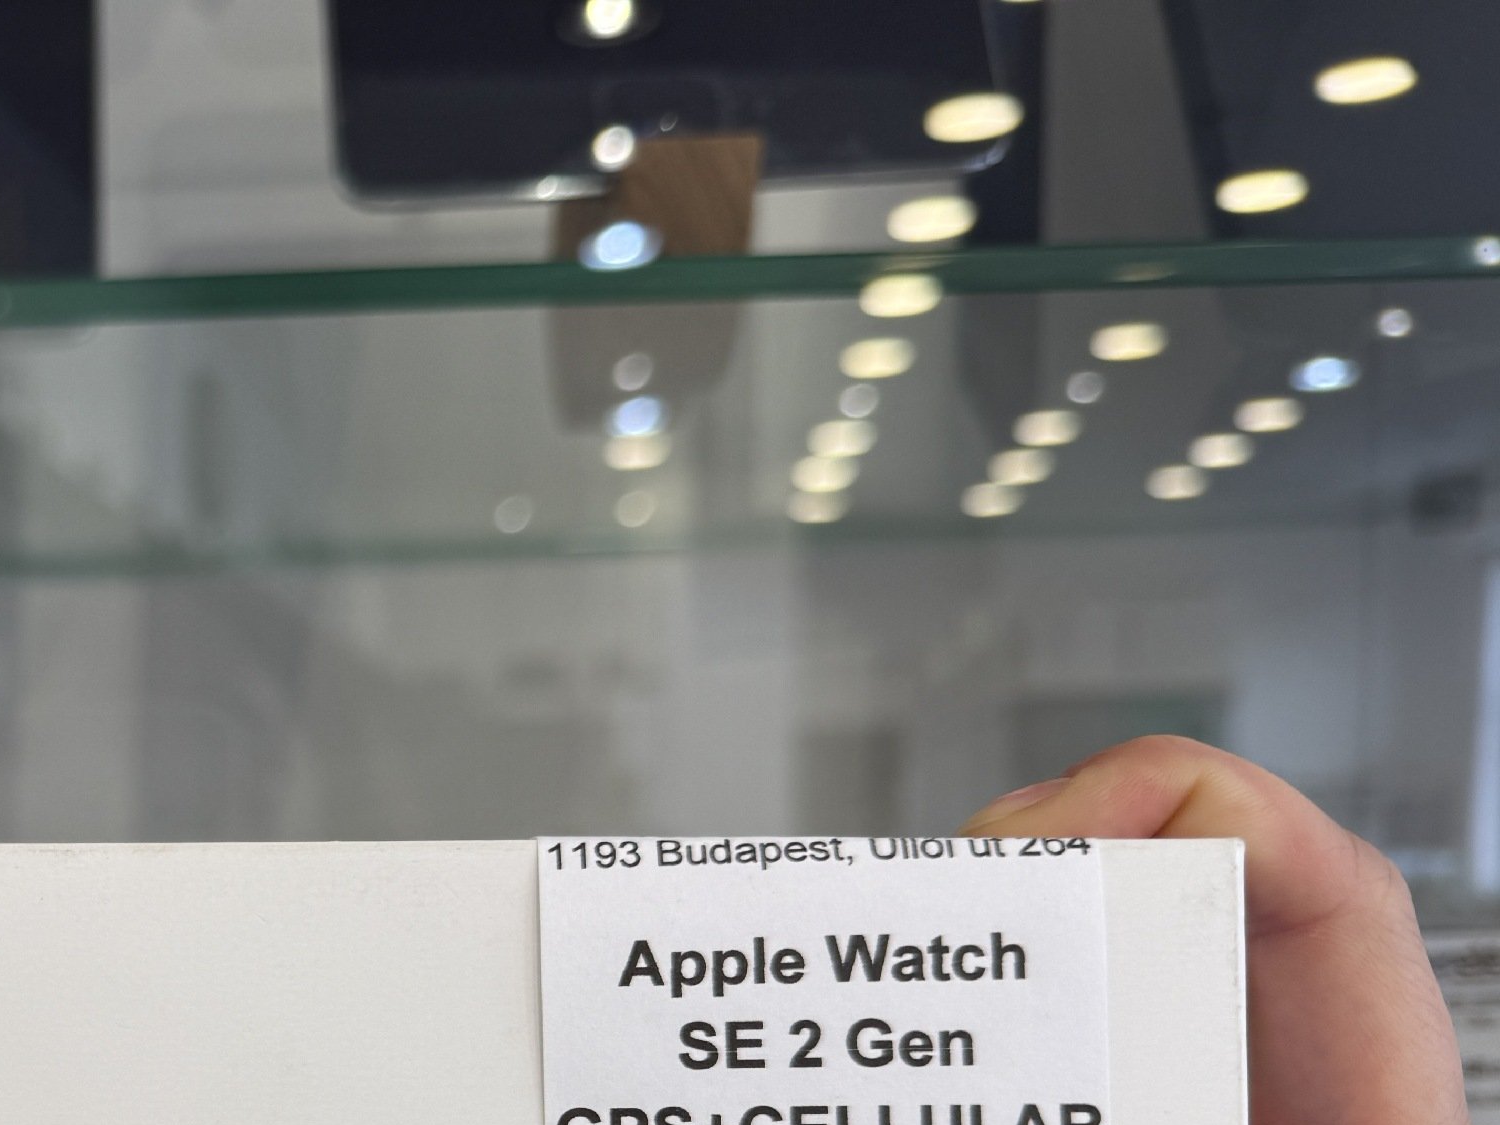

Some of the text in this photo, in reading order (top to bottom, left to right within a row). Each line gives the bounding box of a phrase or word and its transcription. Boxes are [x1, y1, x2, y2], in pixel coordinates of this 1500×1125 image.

[548, 840, 642, 870] 1193
[656, 838, 853, 871] Budapest,
[1019, 837, 1091, 857] 264
[618, 931, 1026, 999] Apple Watch
[678, 1017, 974, 1071] SE 2 Gen
